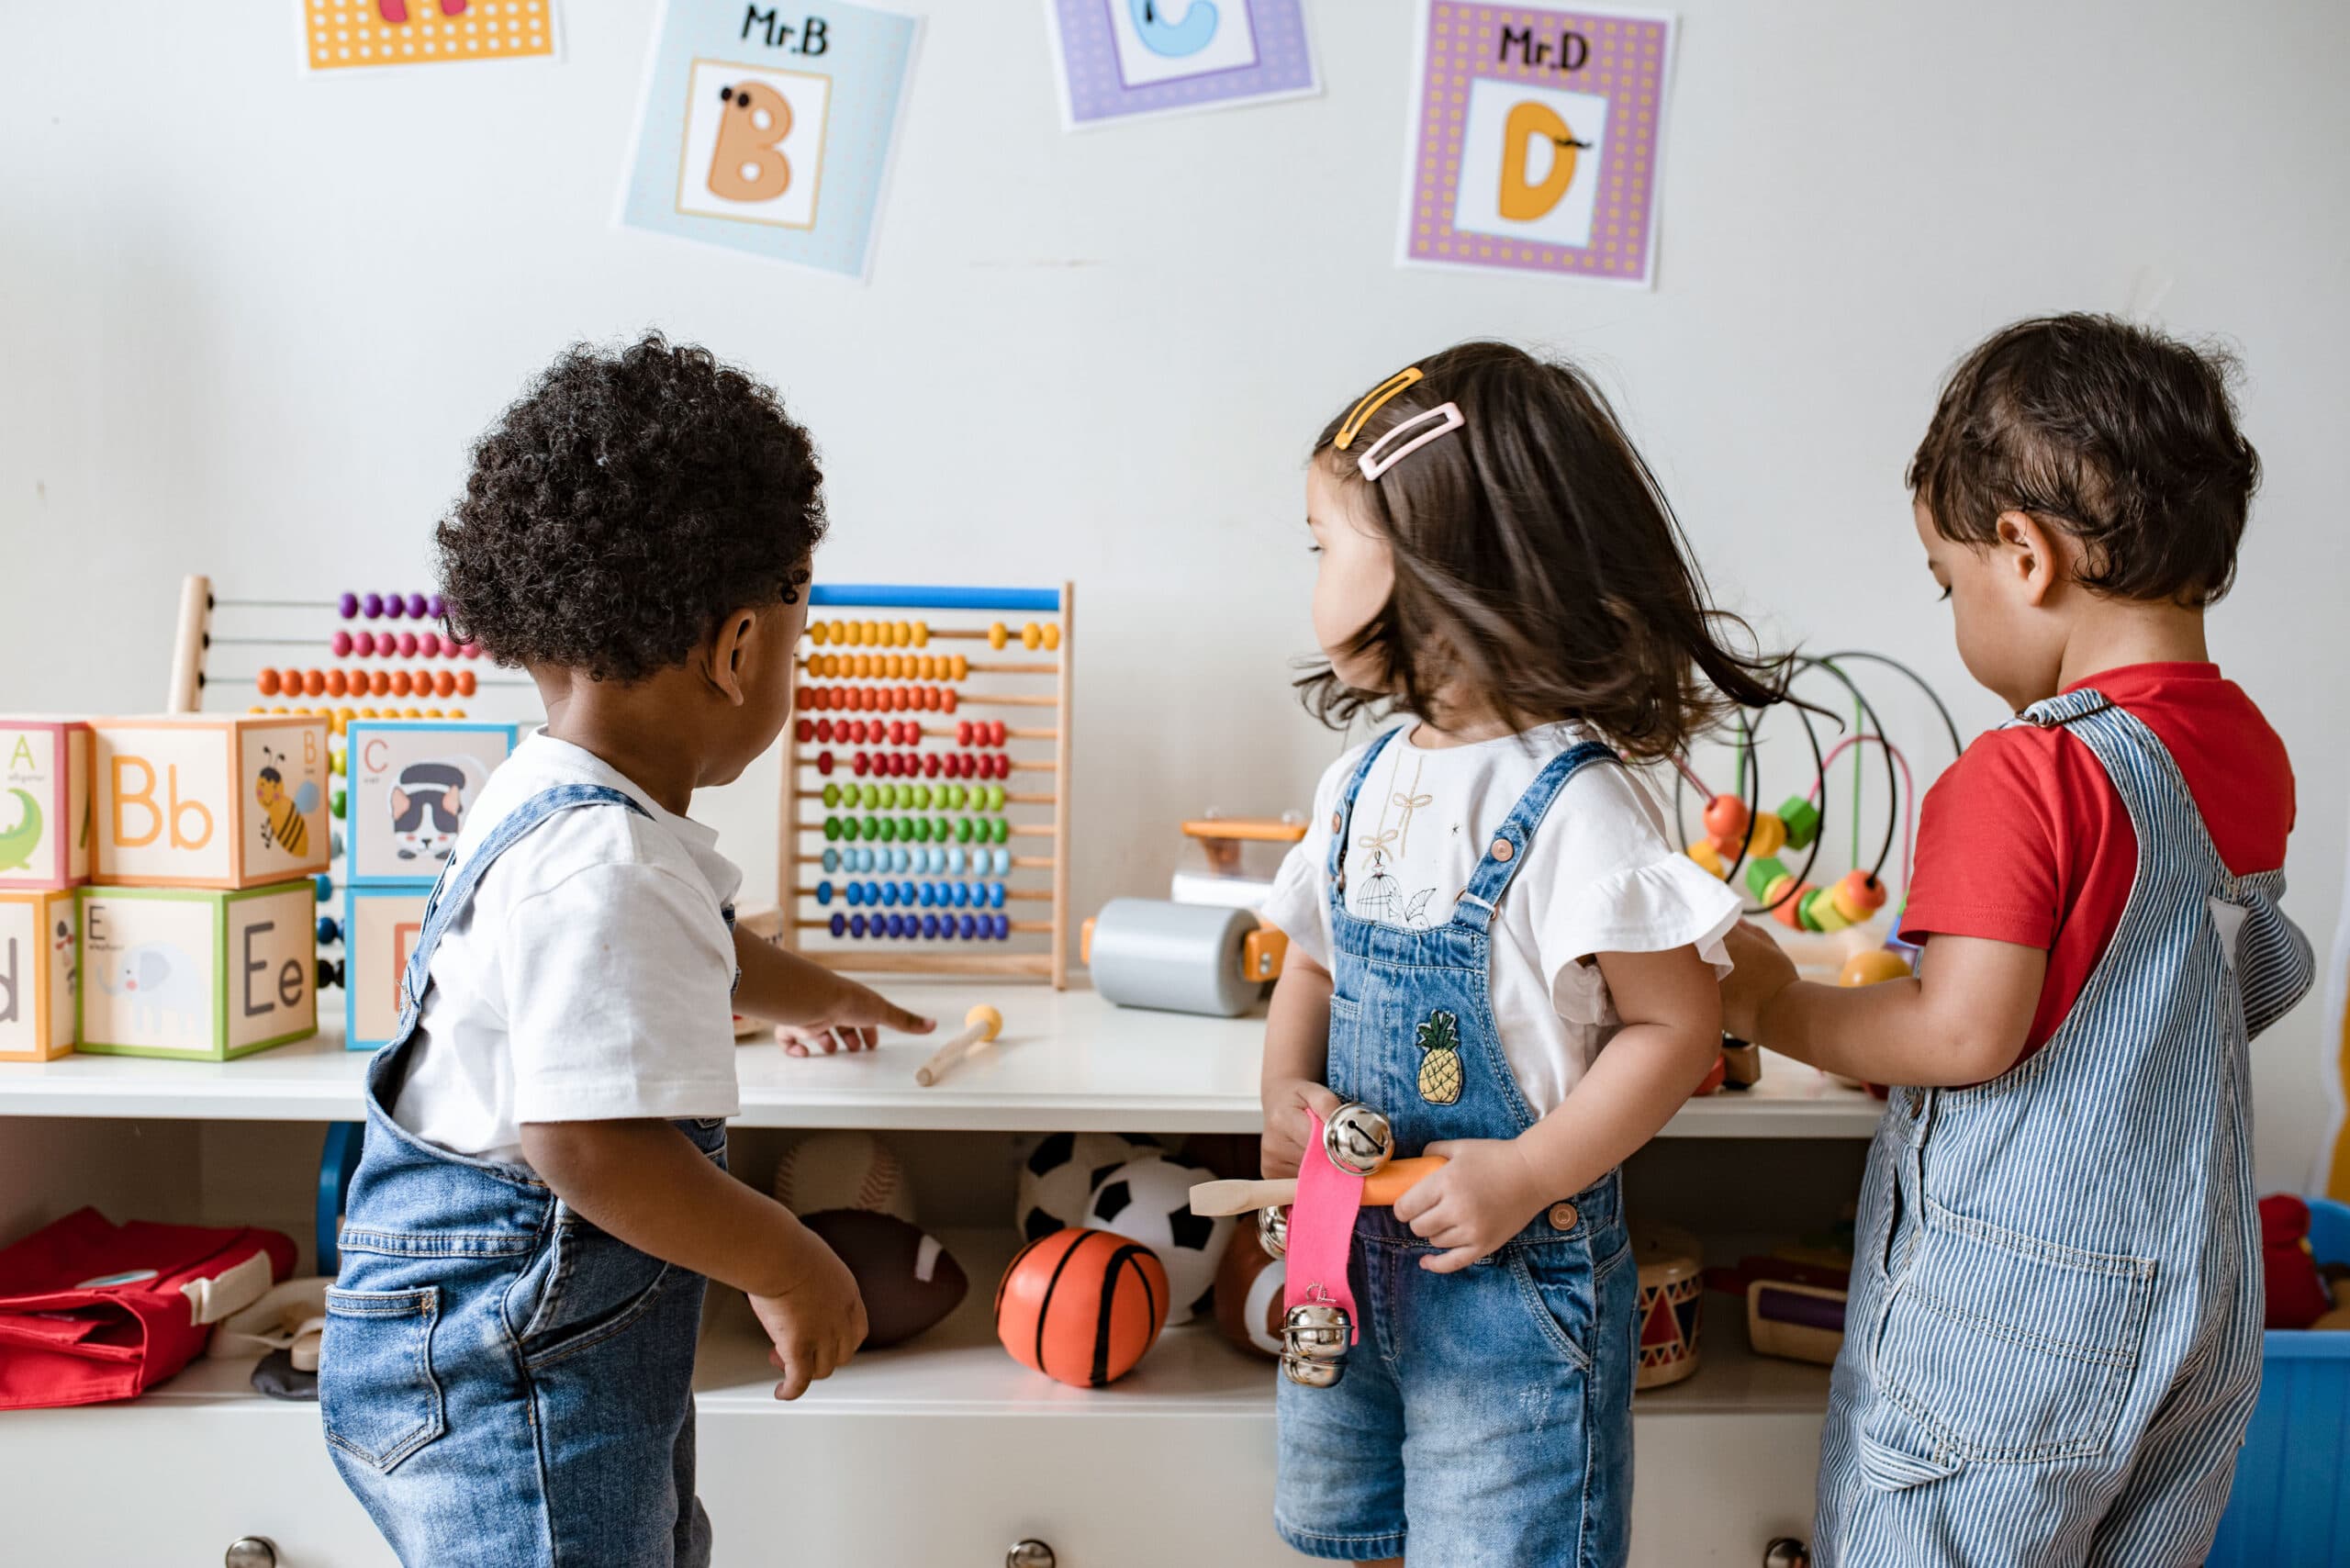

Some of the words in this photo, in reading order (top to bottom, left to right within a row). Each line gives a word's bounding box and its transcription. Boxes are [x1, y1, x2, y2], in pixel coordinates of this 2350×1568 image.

[741, 4, 828, 56] Mr.B
[1499, 25, 1588, 71] Mr.D
[707, 79, 793, 203] B
[1498, 100, 1578, 222] D
[9, 734, 36, 770] A
[304, 730, 317, 764] B
[364, 738, 389, 773] C
[111, 755, 214, 851] Bb
[89, 904, 106, 940] E
[244, 921, 304, 1016] Ee
